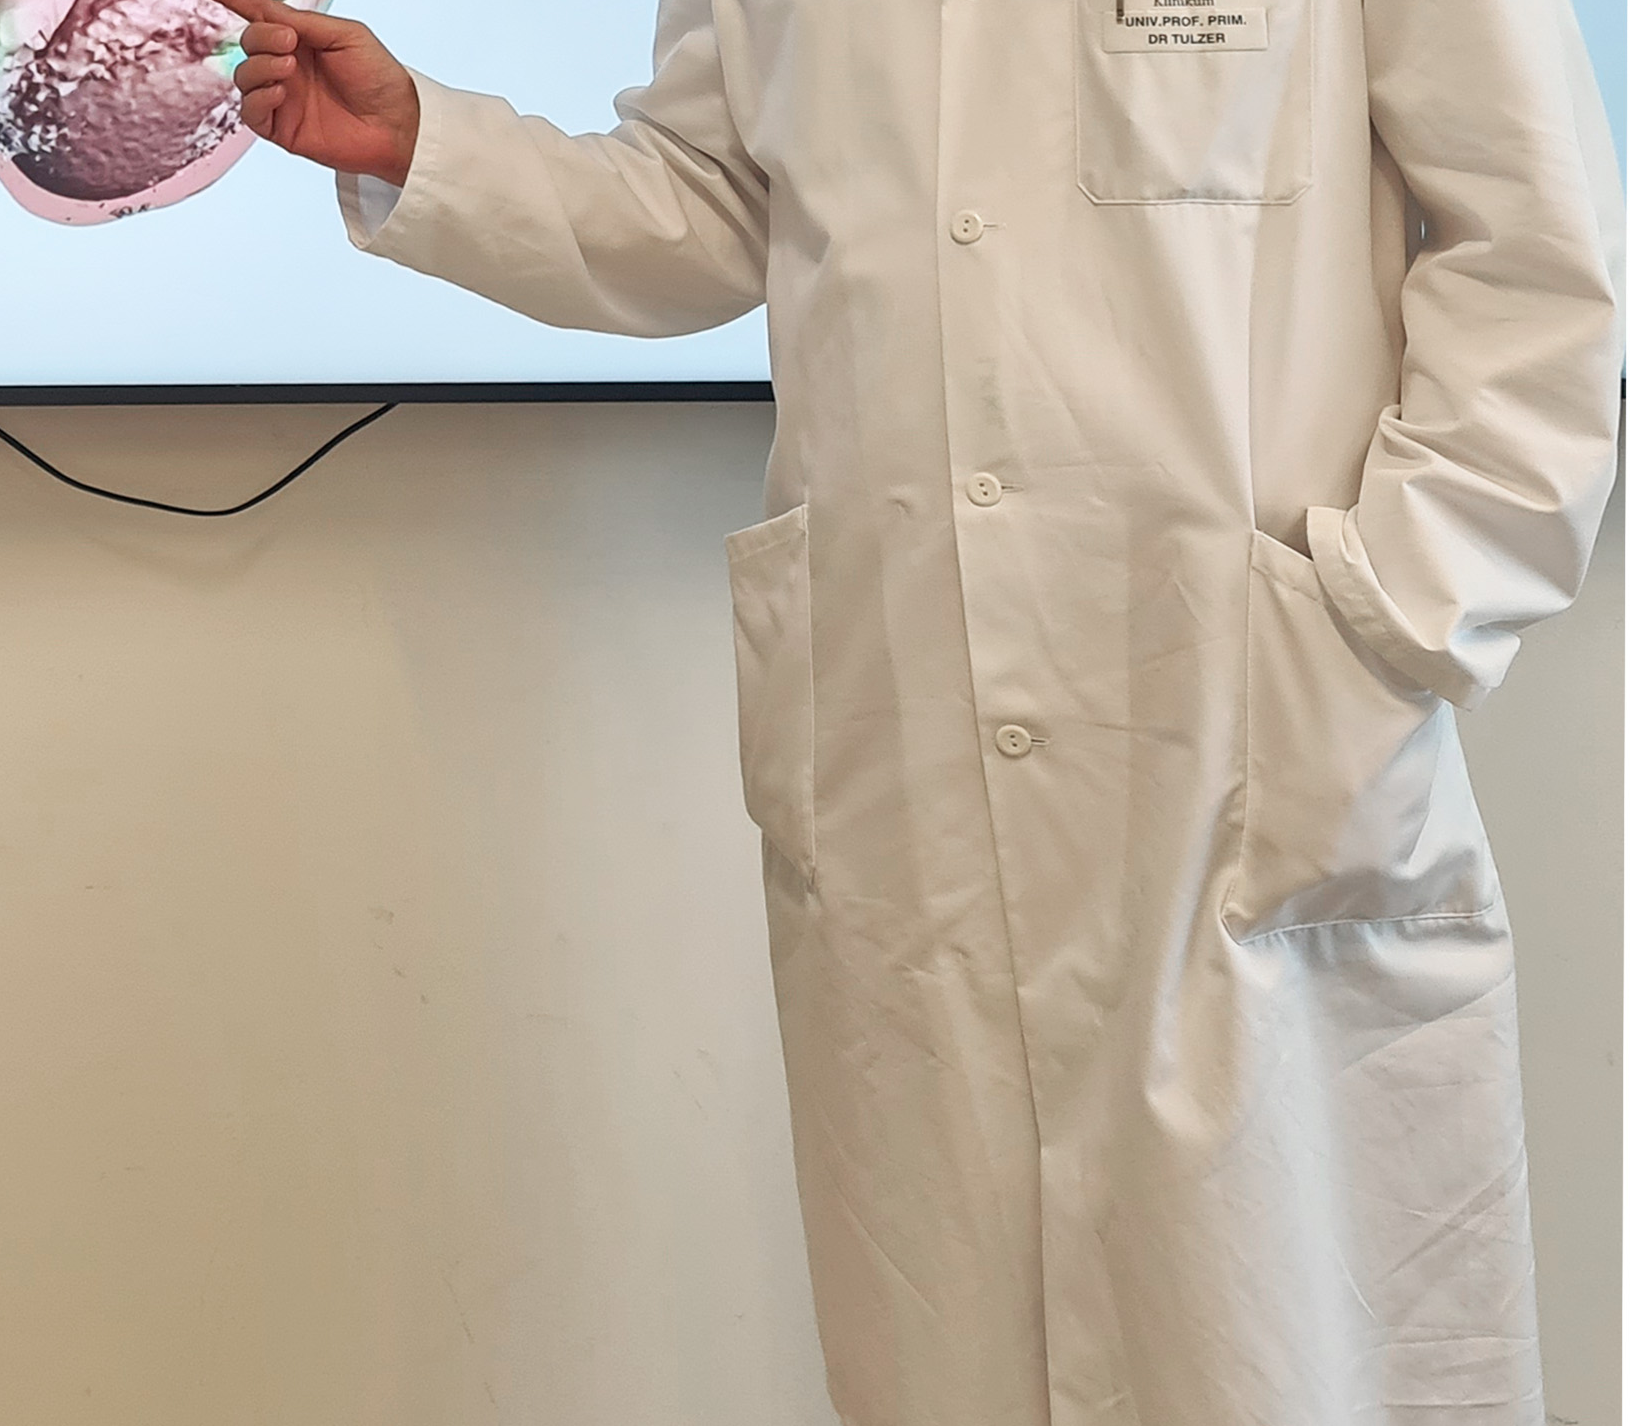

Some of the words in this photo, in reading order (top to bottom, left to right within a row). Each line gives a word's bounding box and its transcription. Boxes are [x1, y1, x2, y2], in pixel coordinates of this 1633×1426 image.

[1207, 14, 1247, 26] PRIM.
[1148, 33, 1168, 45] DR
[1171, 32, 1226, 45] TULZER
